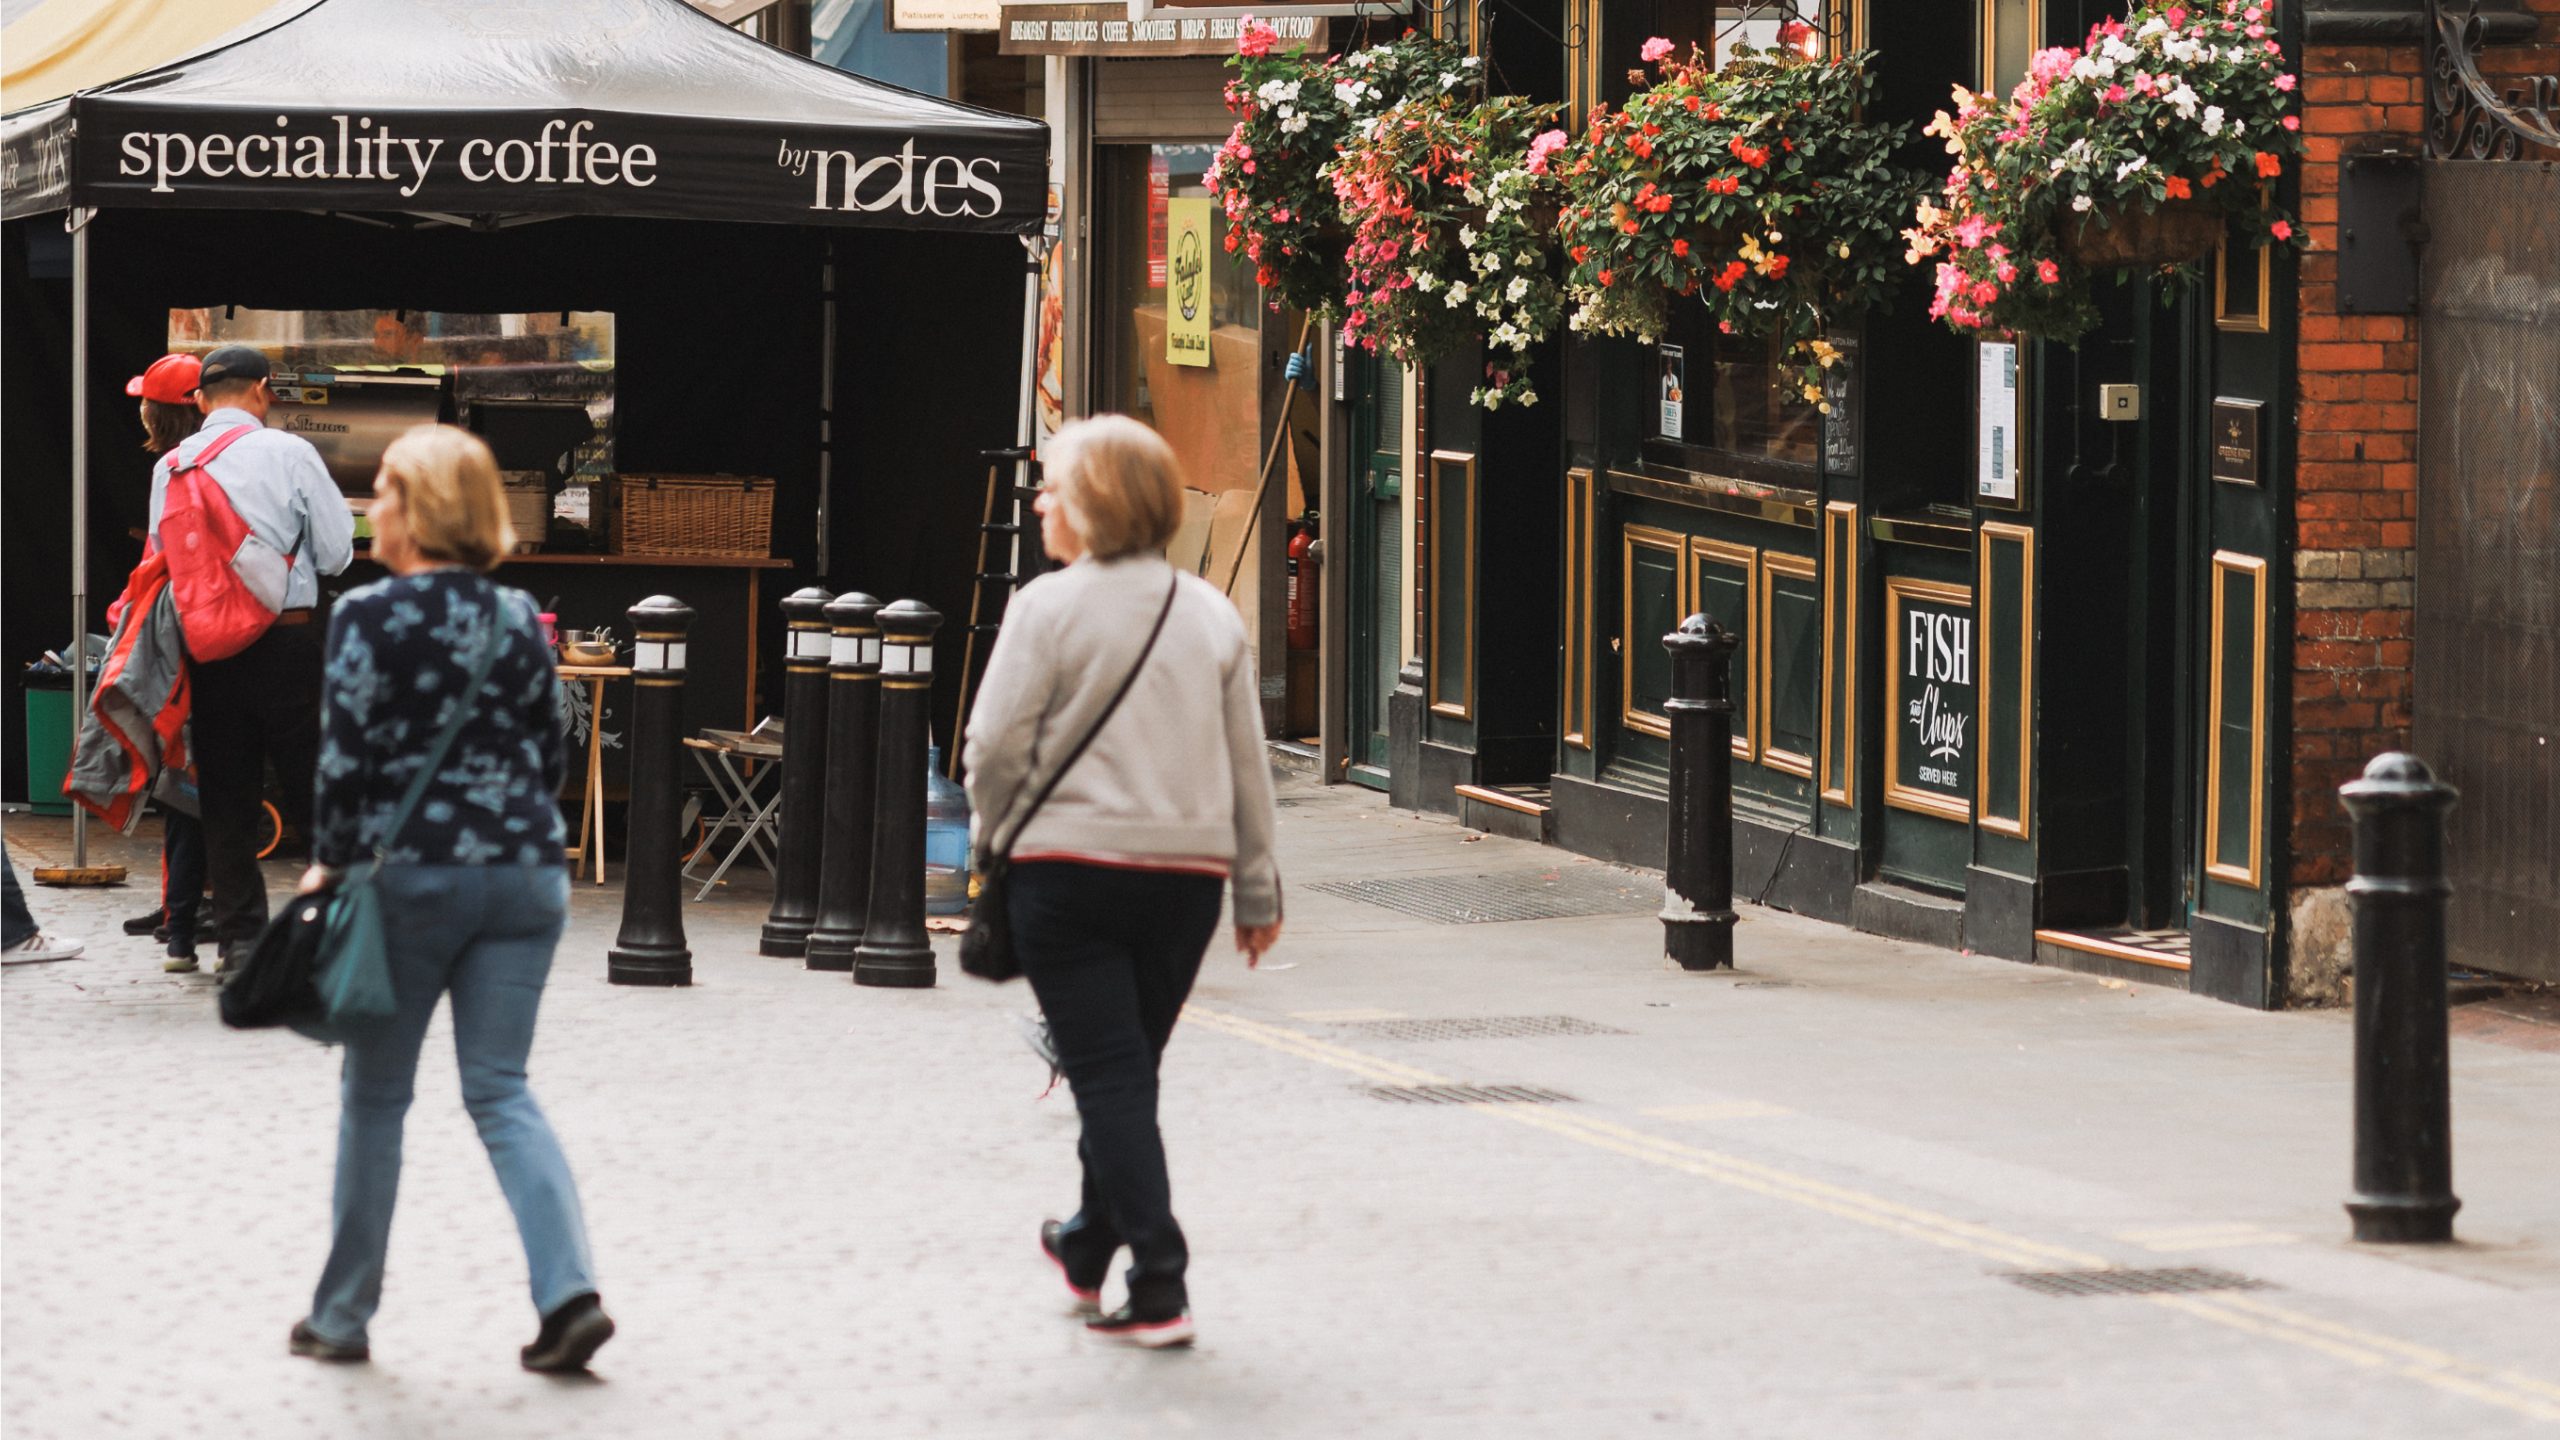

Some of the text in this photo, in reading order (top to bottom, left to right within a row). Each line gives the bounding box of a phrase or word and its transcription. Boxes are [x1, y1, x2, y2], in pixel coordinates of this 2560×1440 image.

[902, 11, 945, 20] Patisserie
[952, 11, 989, 20] Lunches
[1010, 20, 1048, 41] BREAKFAST
[1051, 20, 1074, 41] FRESH
[1072, 20, 1098, 46] JUICES
[1102, 20, 1128, 42] COFFEE
[1132, 19, 1176, 42] SMOOTHIES
[1180, 18, 1206, 40] WRAPS
[1210, 17, 1235, 39] FRESH
[1271, 16, 1290, 38] HOT
[1289, 16, 1314, 38] FOOD
[119, 114, 657, 197] speciality coffee
[777, 136, 1002, 219] by notes
[1908, 610, 1971, 685] FISH
[1919, 683, 1969, 763] Chips
[1918, 765, 1958, 788] SERVED HERE
